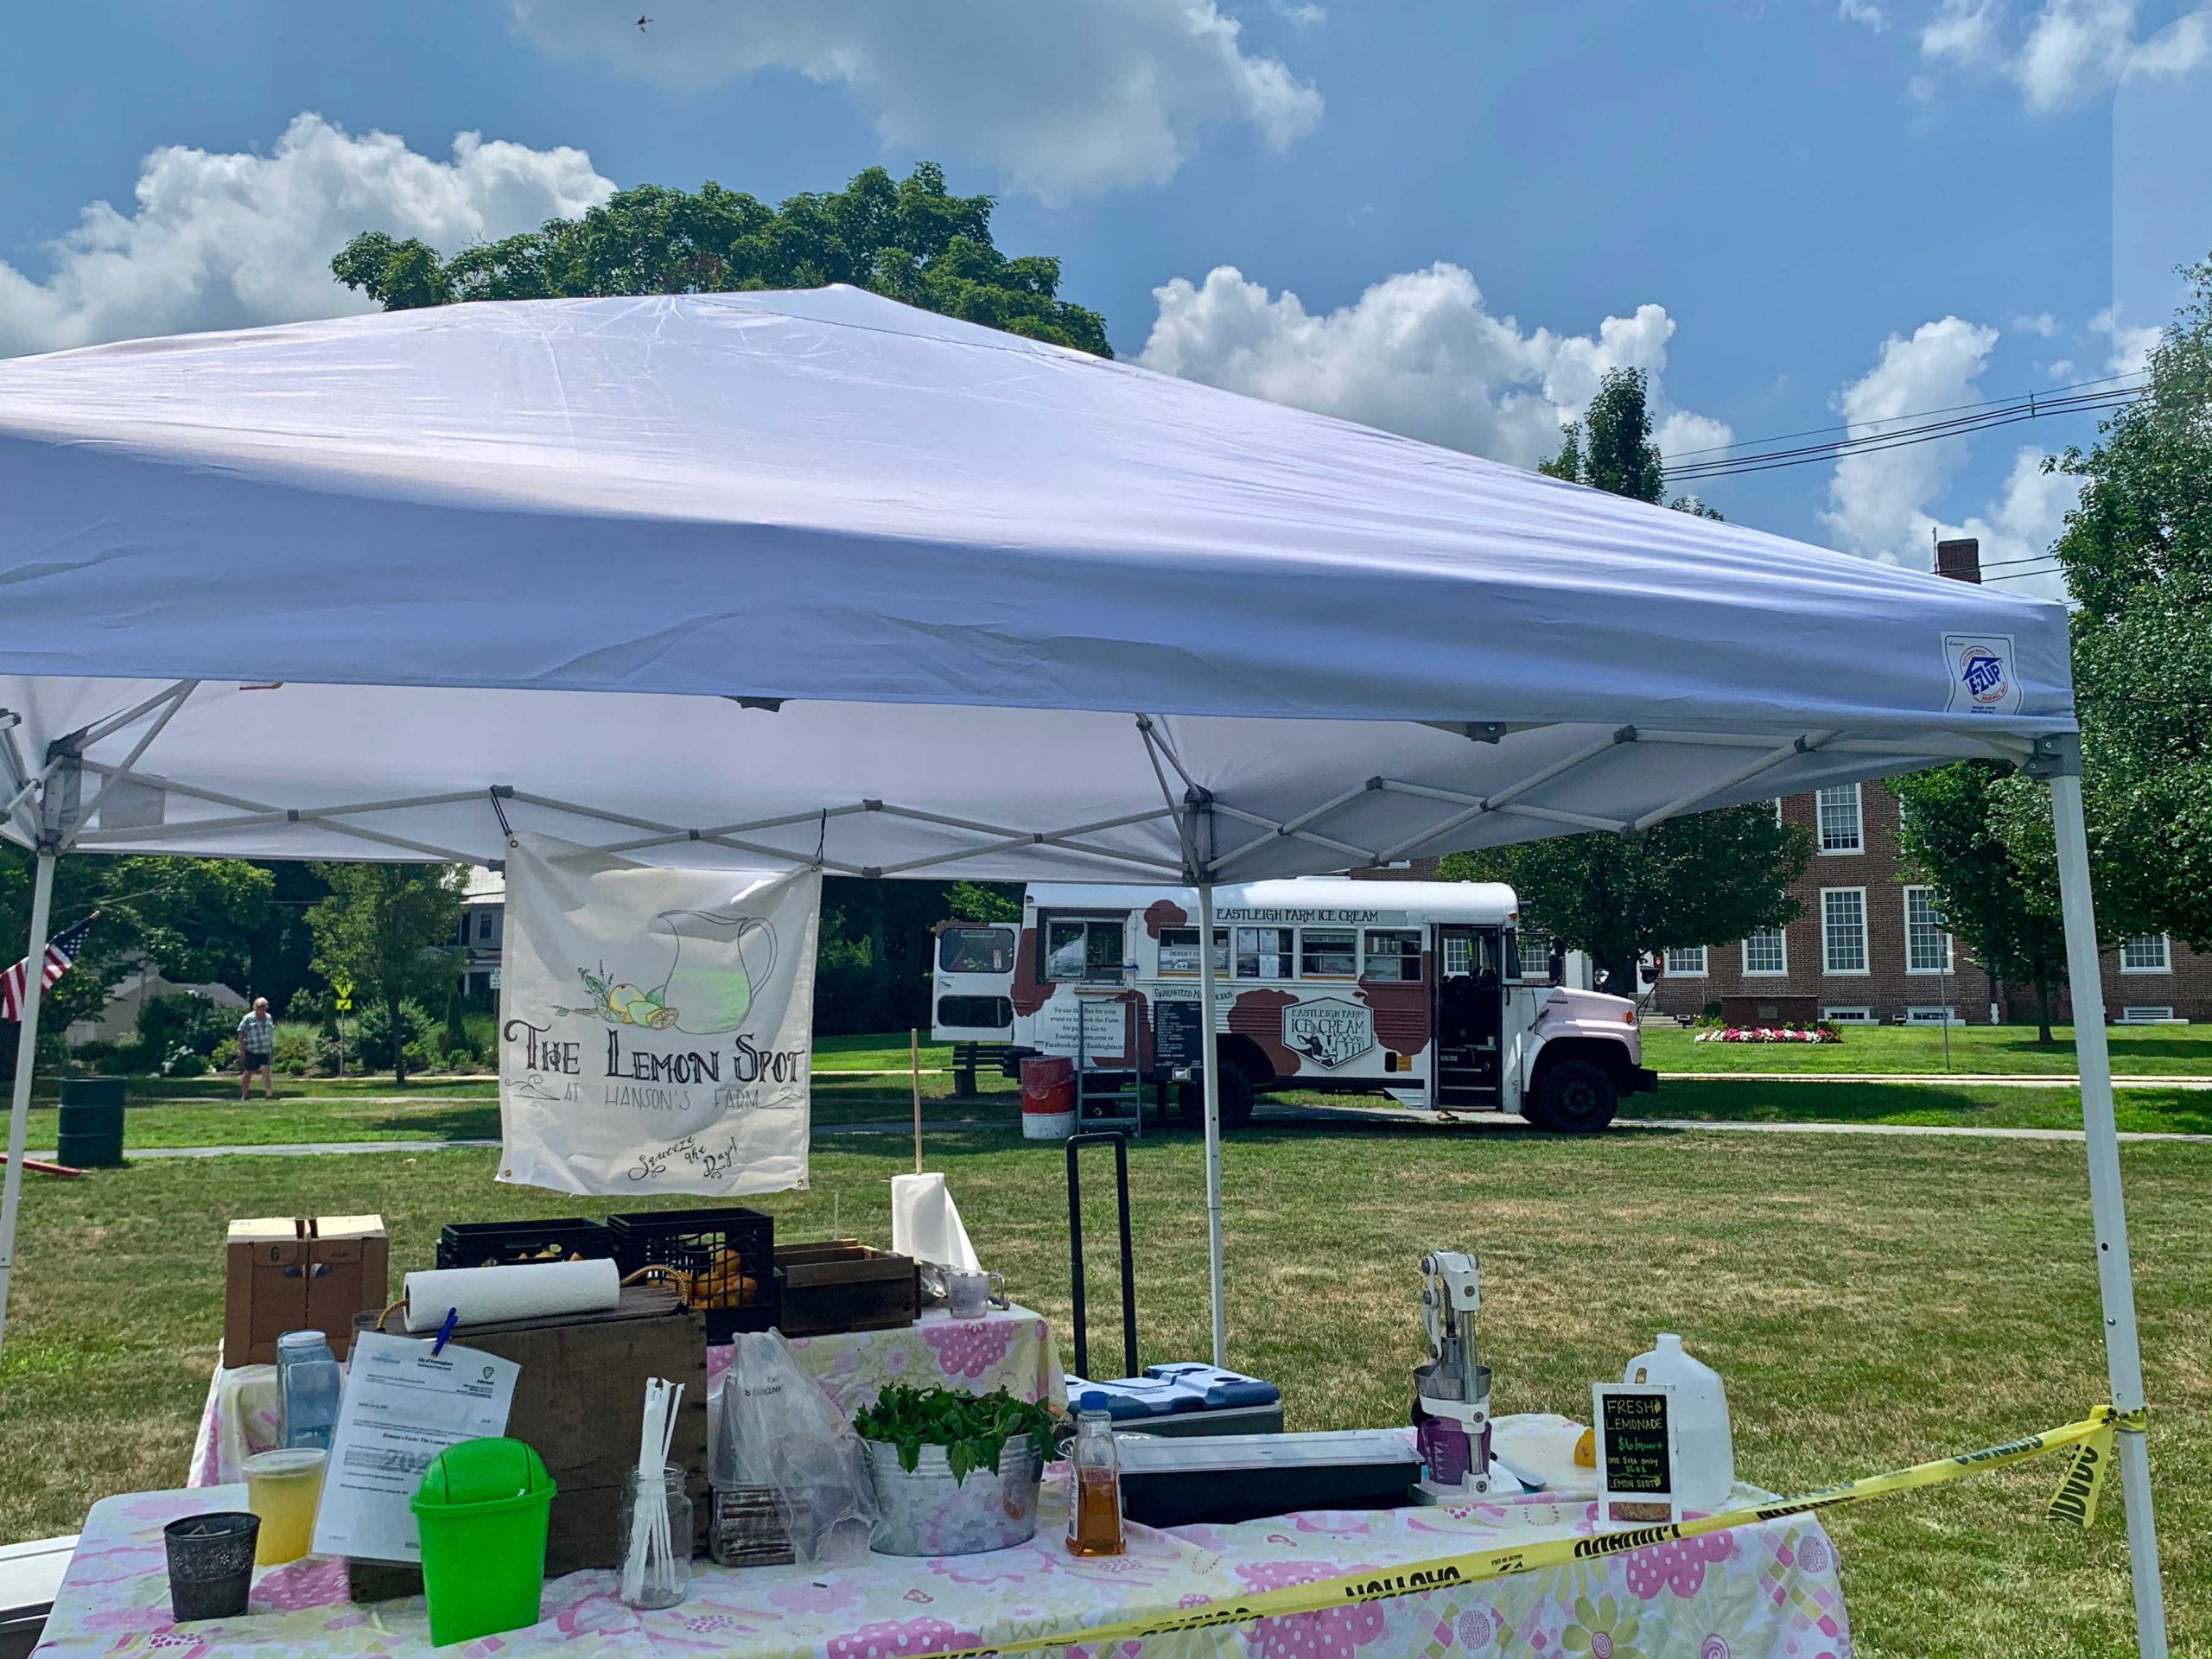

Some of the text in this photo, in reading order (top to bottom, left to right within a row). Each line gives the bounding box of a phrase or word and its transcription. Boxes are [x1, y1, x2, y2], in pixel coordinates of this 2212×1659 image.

[1217, 908, 1379, 924] EASTLEIGH FARM ICE CREAM
[1292, 1008, 1364, 1019] EASTLEIGH FARM
[1292, 1019, 1364, 1037] ICE CREAM
[504, 1020, 805, 1084] THE LEMON SPOT
[563, 1082, 760, 1110] AT HANSON'S FARM
[628, 1136, 695, 1181] Squeeze
[703, 1136, 739, 1179] Day!
[1607, 1400, 1654, 1414] FRESH
[1605, 1417, 1663, 1431] LEMONADE
[1618, 1435, 1663, 1452] $6/quart
[1641, 1458, 1658, 1468] only
[1609, 1478, 1655, 1489] LEMON SPOT
